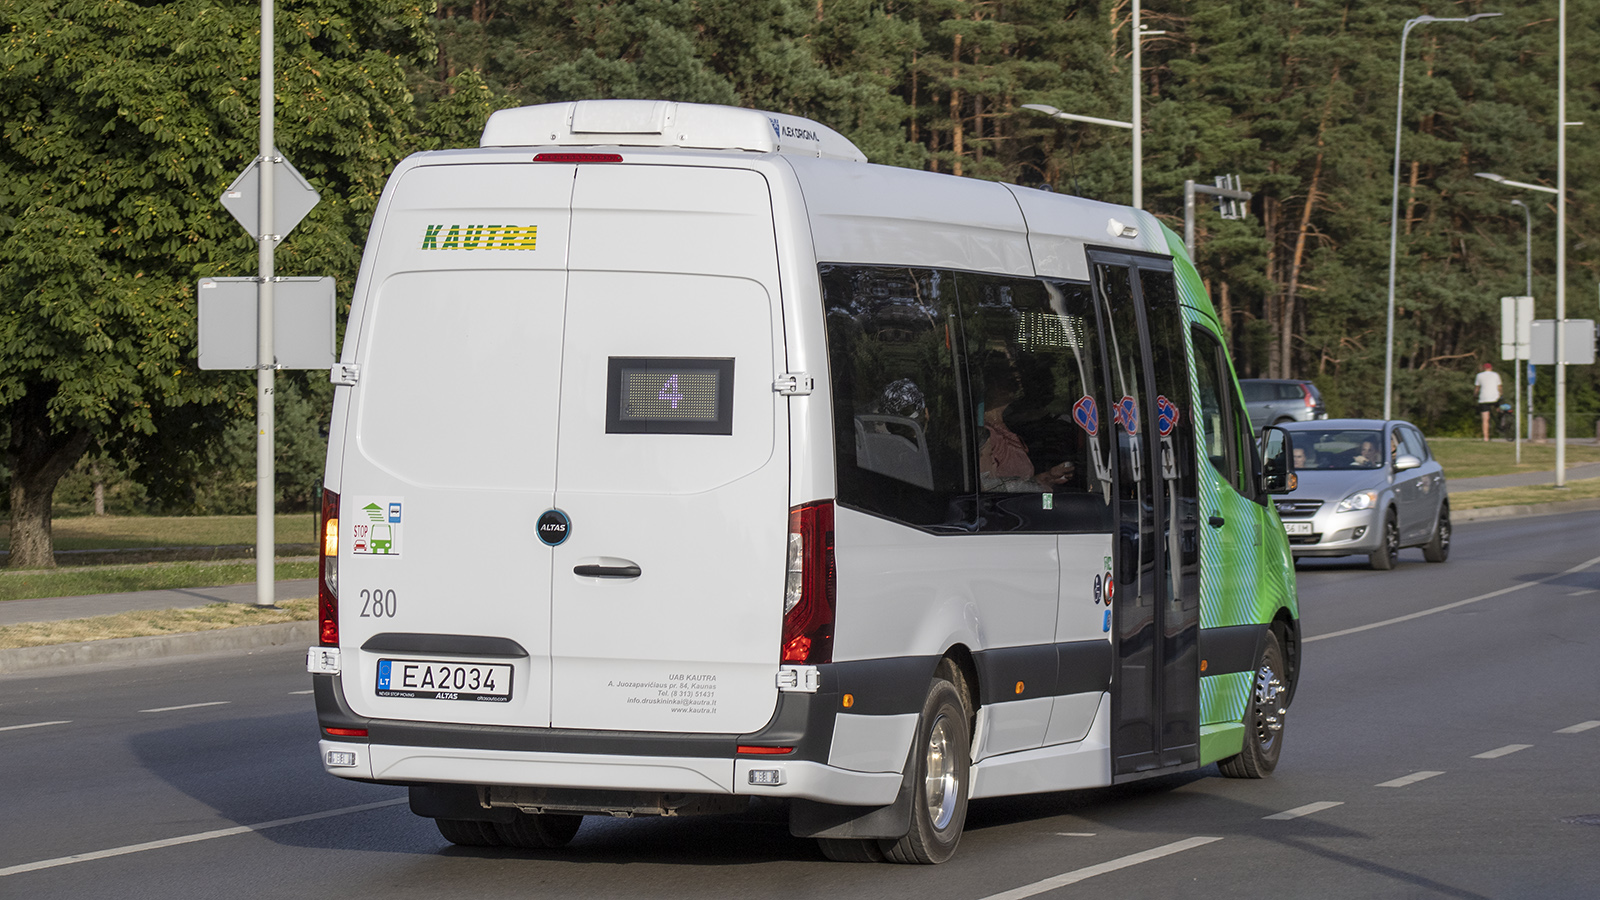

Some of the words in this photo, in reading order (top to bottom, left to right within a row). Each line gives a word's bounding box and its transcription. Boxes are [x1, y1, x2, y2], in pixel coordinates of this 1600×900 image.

[421, 224, 538, 250] KAUTRA
[658, 374, 683, 408] 4
[354, 524, 368, 538] STOP
[540, 524, 566, 532] ALTAS
[360, 588, 397, 618] 280
[403, 664, 496, 692] EA2034
[626, 697, 716, 706] info.druskininkai@kautra.lt
[670, 690, 678, 698] (8
